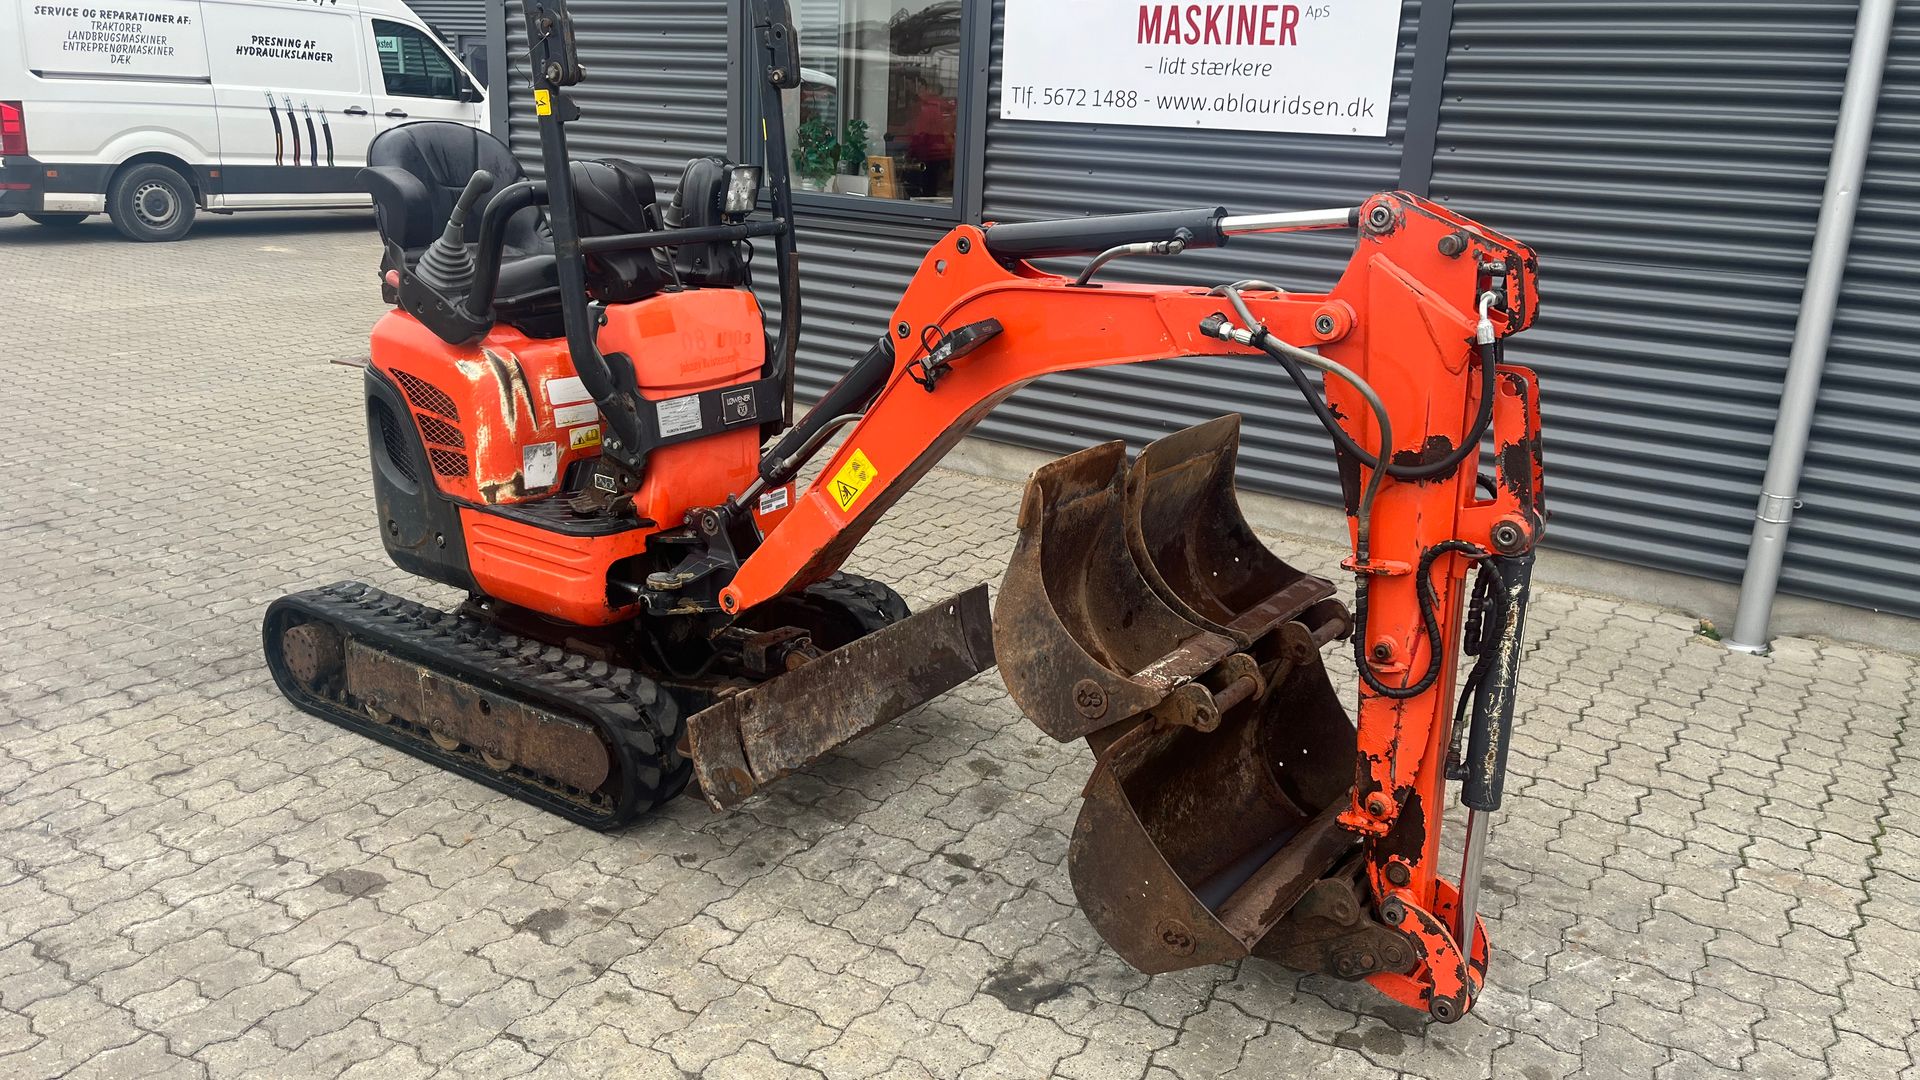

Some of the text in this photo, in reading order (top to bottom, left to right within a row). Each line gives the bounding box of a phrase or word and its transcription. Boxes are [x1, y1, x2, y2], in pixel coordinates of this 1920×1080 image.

[34, 6, 192, 25] SERVICE OG REPARATIONER AF:
[91, 20, 142, 33] TRAKTORER
[1137, 4, 1331, 46] MASKINER ApS
[67, 30, 167, 46] LANDBRUGSMASKINER
[251, 35, 317, 50] PRESNING AF
[62, 41, 175, 57] ENTREPRENØRMASKINER
[235, 45, 333, 63] HYDRAULIKSLANGER
[110, 54, 132, 65] DÆK
[1158, 56, 1187, 75] lidt
[1190, 57, 1273, 77] stærkere
[1011, 86, 1037, 109] Tlf.
[1043, 87, 1086, 107] 5672
[1092, 89, 1138, 109] 1488
[1156, 92, 1375, 118] www.ablauridsen.dk
